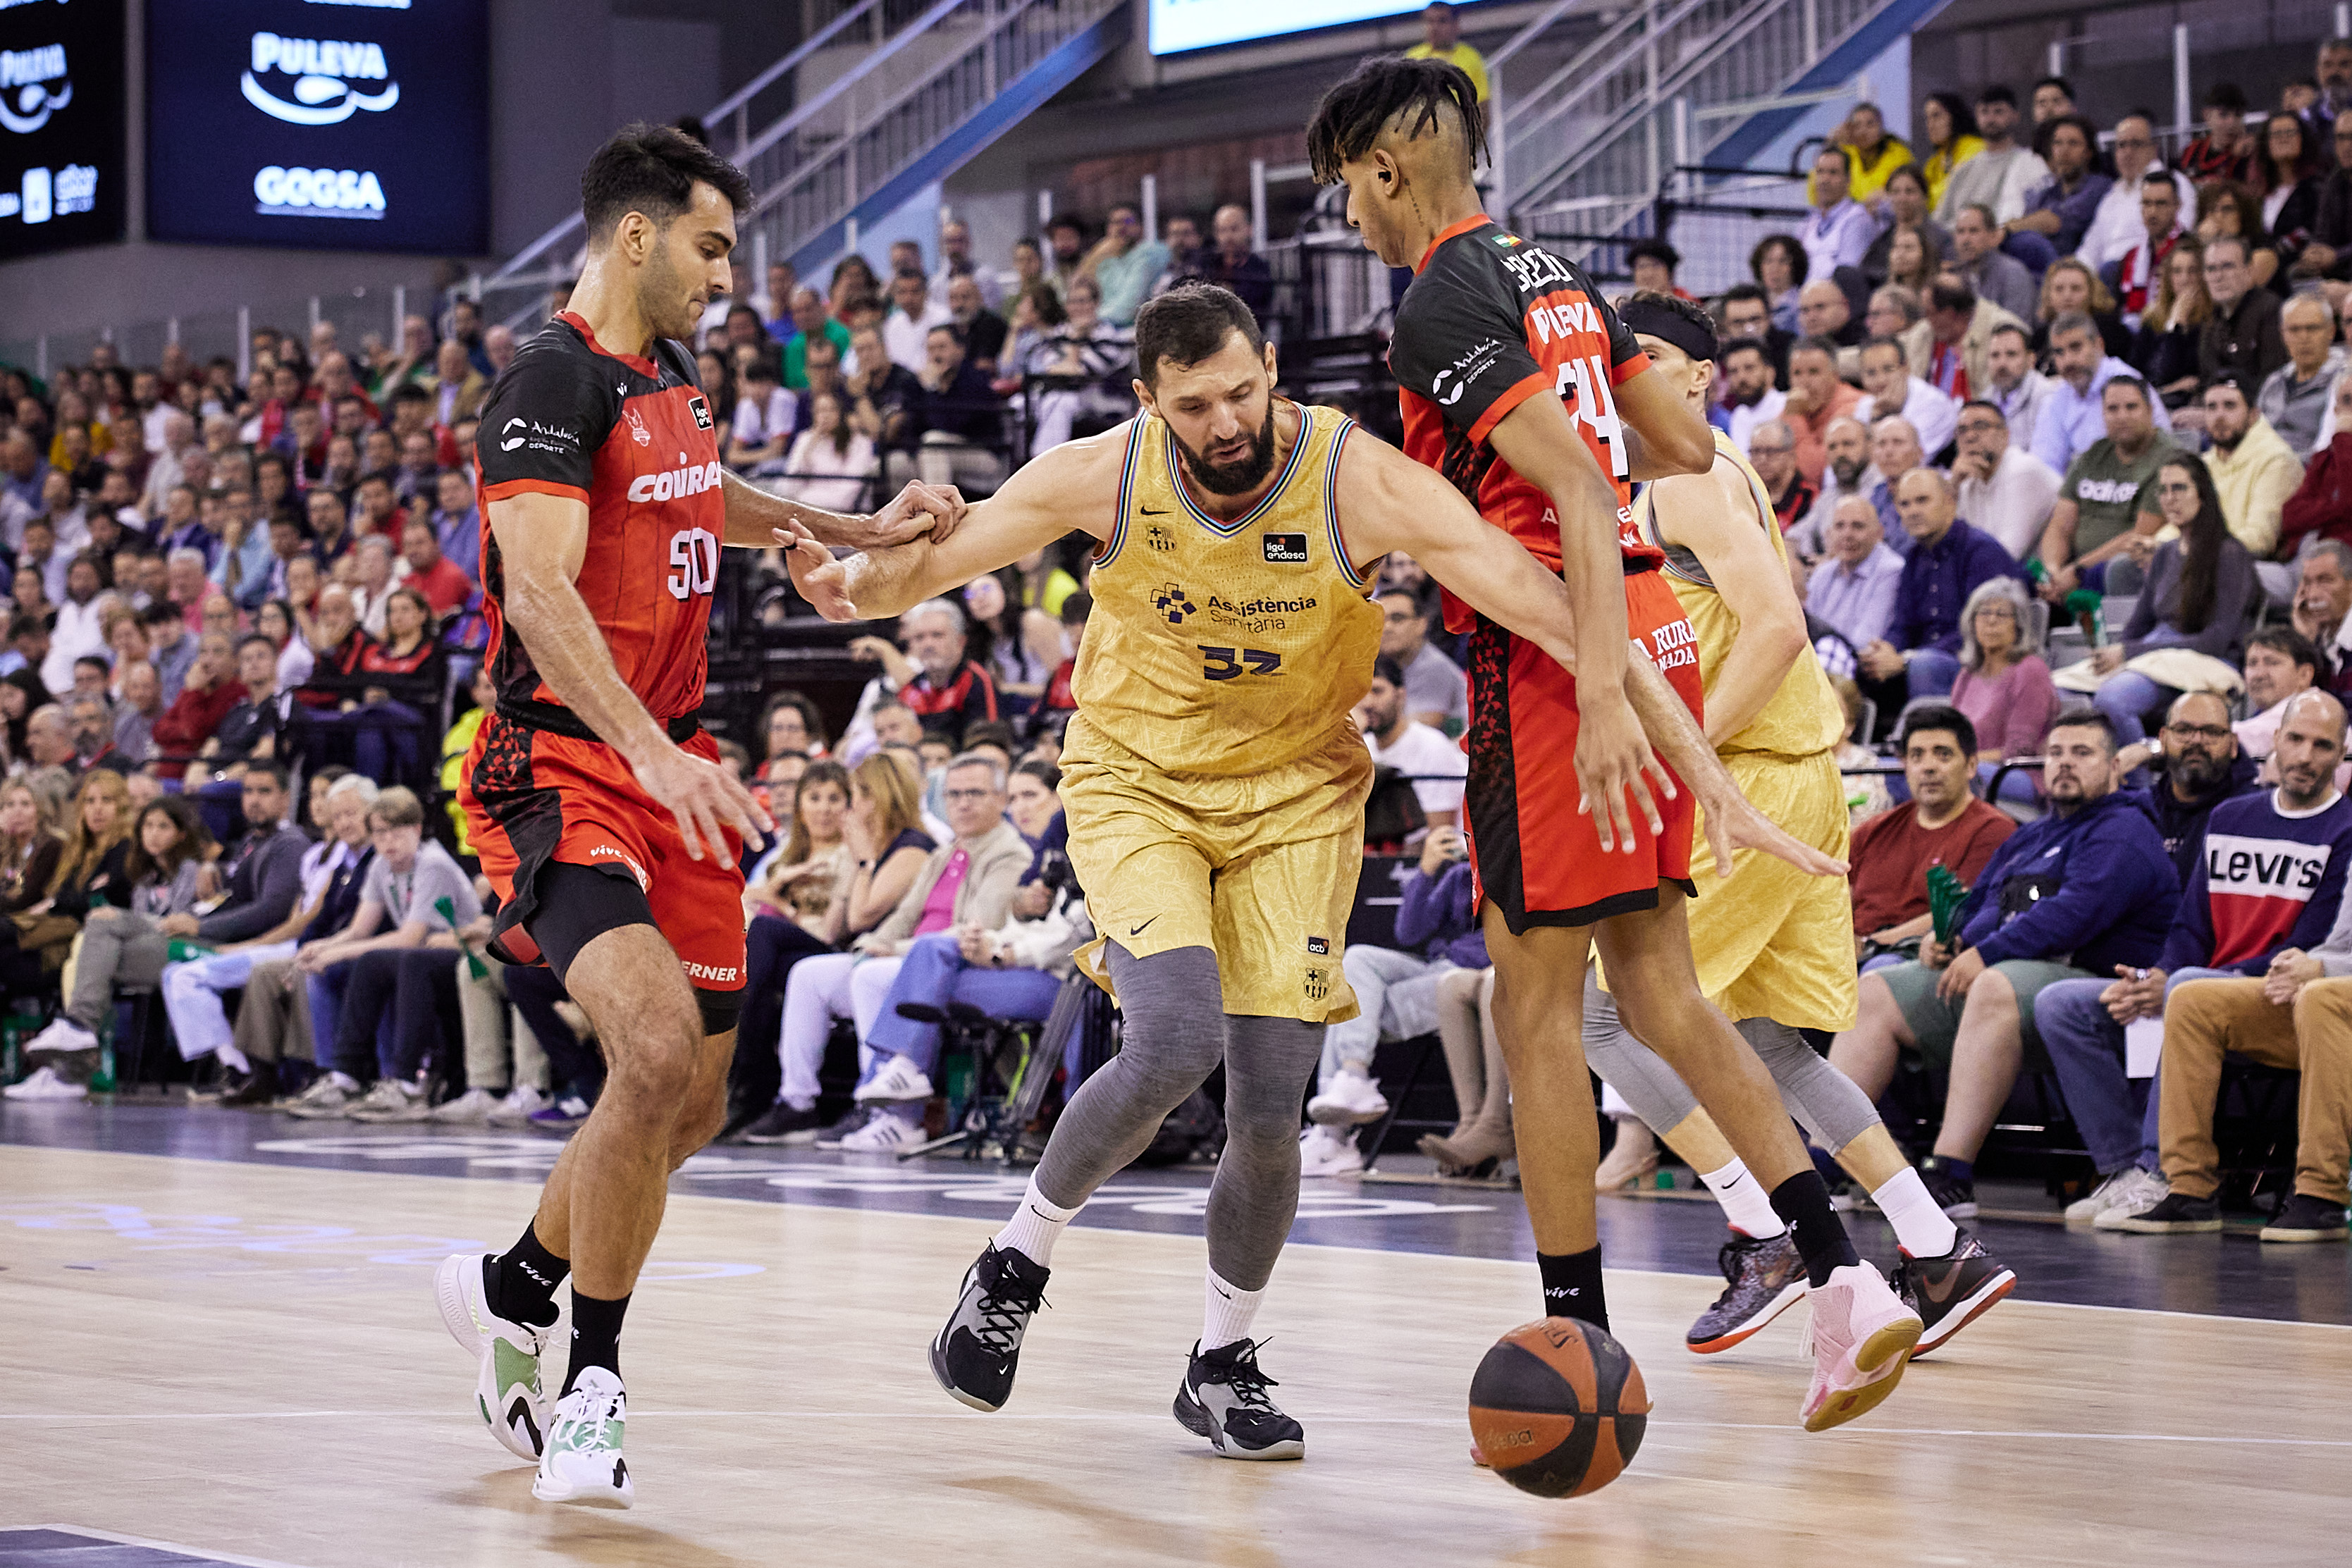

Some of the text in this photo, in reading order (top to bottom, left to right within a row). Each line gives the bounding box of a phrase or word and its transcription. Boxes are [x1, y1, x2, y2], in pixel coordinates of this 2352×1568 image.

[252, 32, 387, 79] PULEVA
[529, 443, 564, 454] DEPORTE
[627, 452, 722, 502] COVIRA
[1267, 543, 1284, 552] liga
[1267, 551, 1305, 560] endesa
[667, 527, 718, 600] 50
[1208, 595, 1317, 617] Assistència
[590, 844, 622, 857] vive
[1310, 944, 1325, 953] acb
[1546, 1287, 1580, 1298] vive
